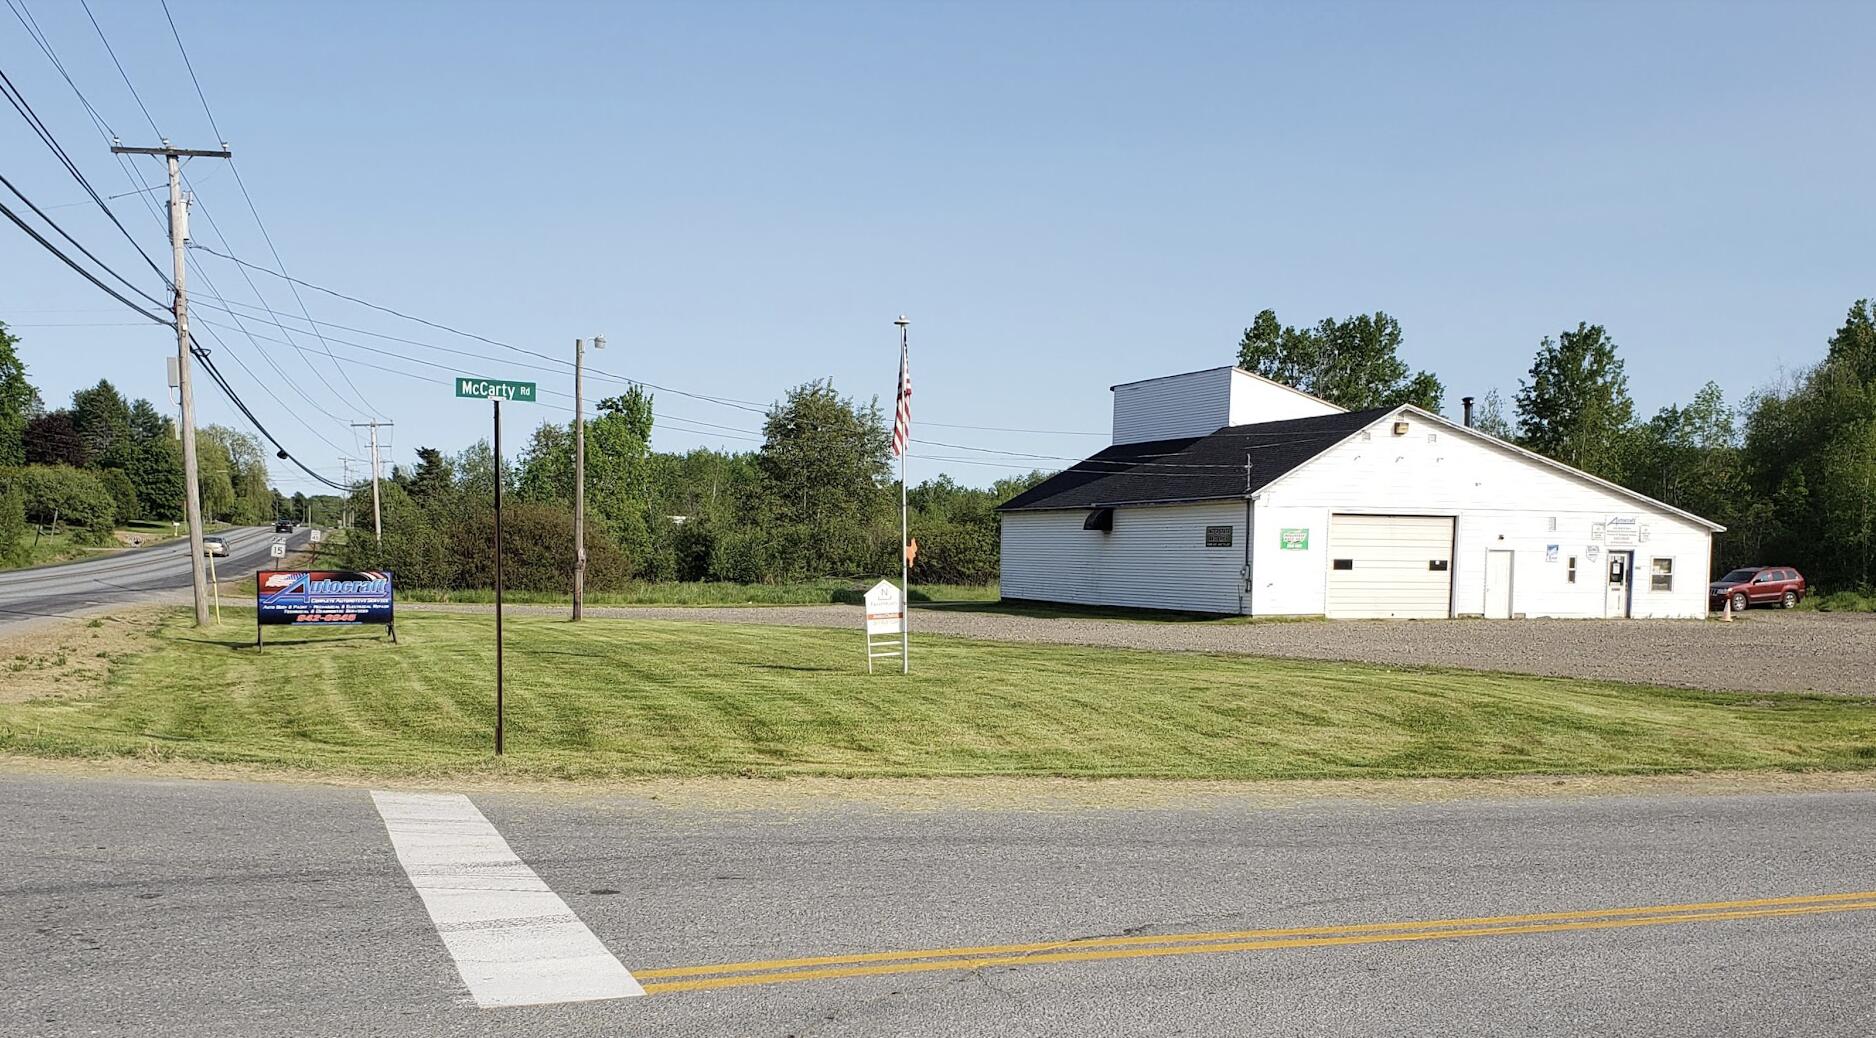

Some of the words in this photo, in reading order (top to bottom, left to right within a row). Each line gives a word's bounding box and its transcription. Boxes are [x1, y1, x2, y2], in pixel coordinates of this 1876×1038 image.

[462, 380, 515, 400] McCarty
[520, 386, 531, 396] Rd
[274, 546, 283, 555] 15
[263, 573, 387, 604] Autocraft
